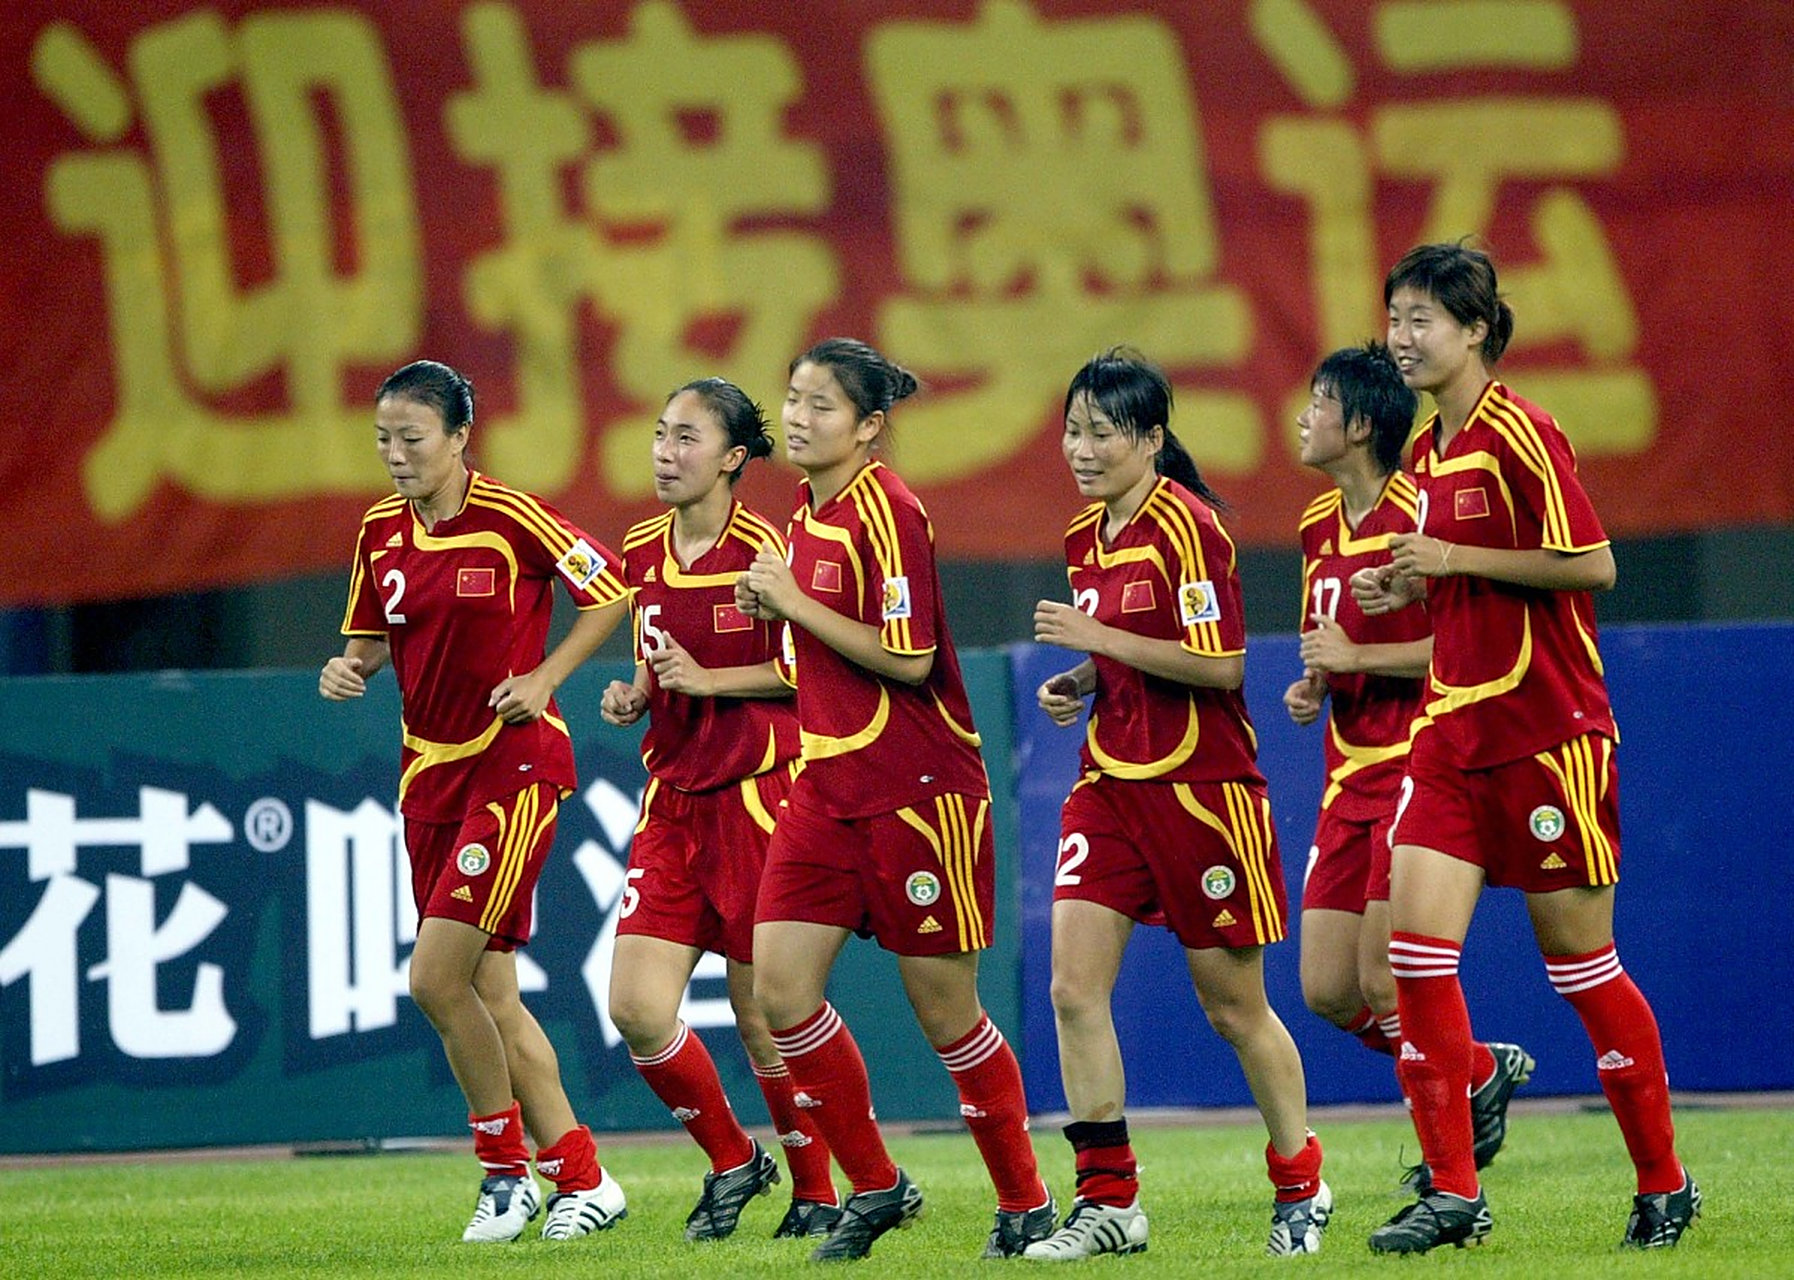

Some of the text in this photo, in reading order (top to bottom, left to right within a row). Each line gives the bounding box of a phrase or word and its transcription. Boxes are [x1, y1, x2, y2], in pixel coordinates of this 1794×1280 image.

[32, 0, 1659, 524] 迎接奥运
[382, 569, 406, 624] 2
[1312, 577, 1341, 626] 17
